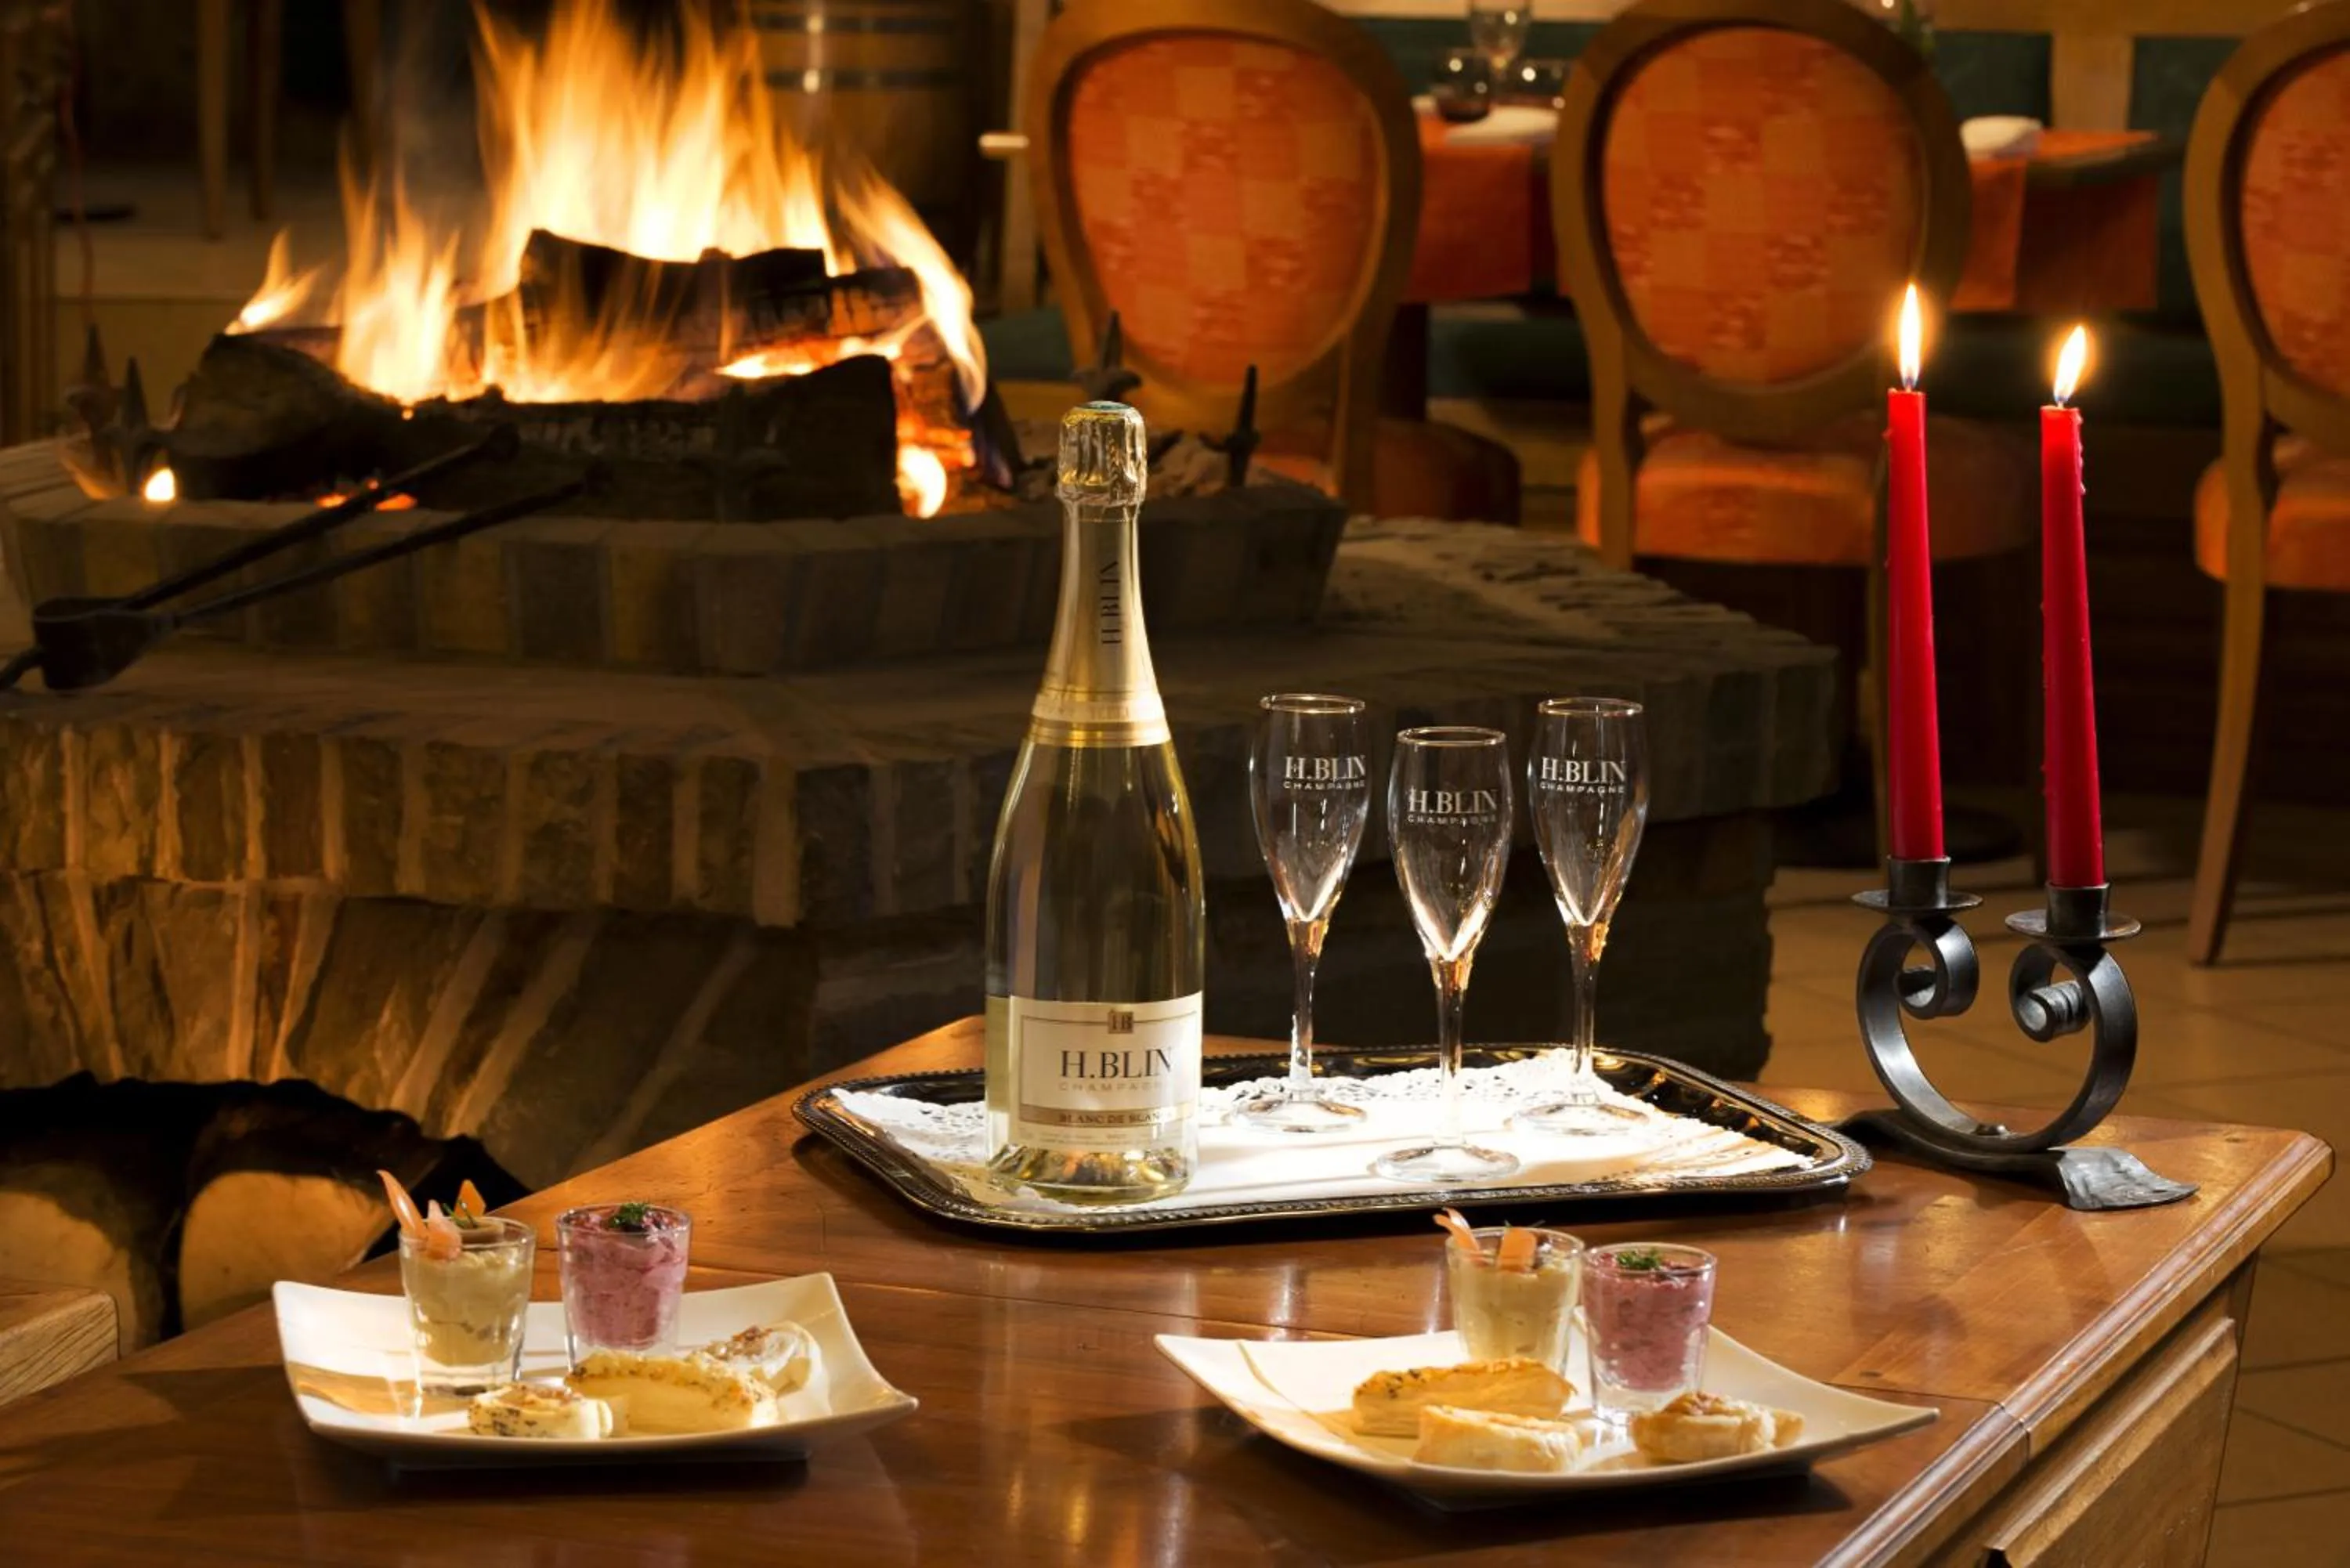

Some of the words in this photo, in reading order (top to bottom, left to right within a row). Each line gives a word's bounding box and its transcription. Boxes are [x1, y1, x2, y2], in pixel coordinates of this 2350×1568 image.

[1100, 559, 1123, 645] HBLIN
[1285, 755, 1366, 780] H.BLIN
[1541, 757, 1627, 783] H.BLIN
[1407, 786, 1499, 814] H.BLIN
[1539, 782, 1625, 793] CHAMPAGNE
[1059, 1047, 1173, 1079] H.BLIN
[1058, 1081, 1166, 1093] CHAMPAG
[1058, 1112, 1103, 1124] BLANC
[1108, 1113, 1125, 1124] DE
[1129, 1111, 1166, 1124] BLAN
